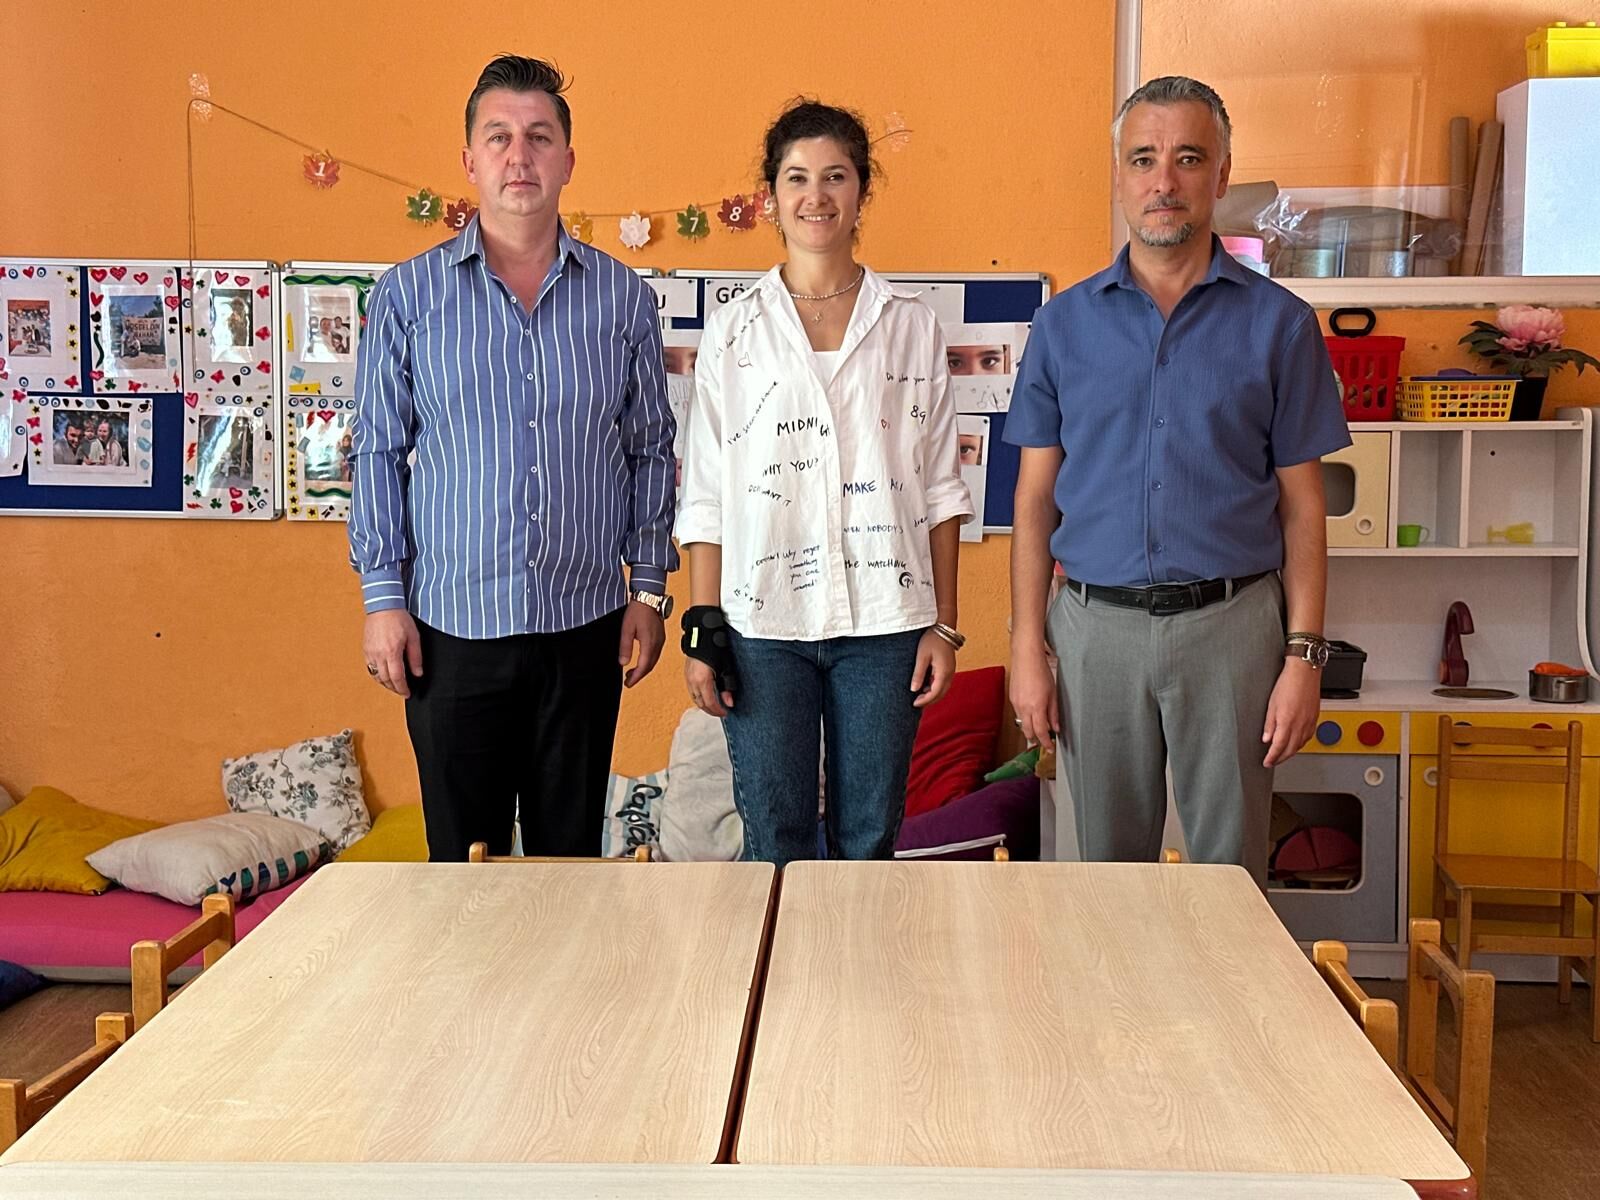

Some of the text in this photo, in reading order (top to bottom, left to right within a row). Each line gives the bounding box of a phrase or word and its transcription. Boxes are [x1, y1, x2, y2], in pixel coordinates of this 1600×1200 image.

[314, 161, 326, 177] 1
[419, 200, 431, 216] 2
[729, 206, 742, 222] 8
[454, 212, 466, 228] 3
[689, 217, 700, 233] 7
[571, 224, 582, 240] 5
[715, 283, 751, 304] GÖ
[843, 480, 878, 498] MAKE
[615, 783, 663, 855] Capta
